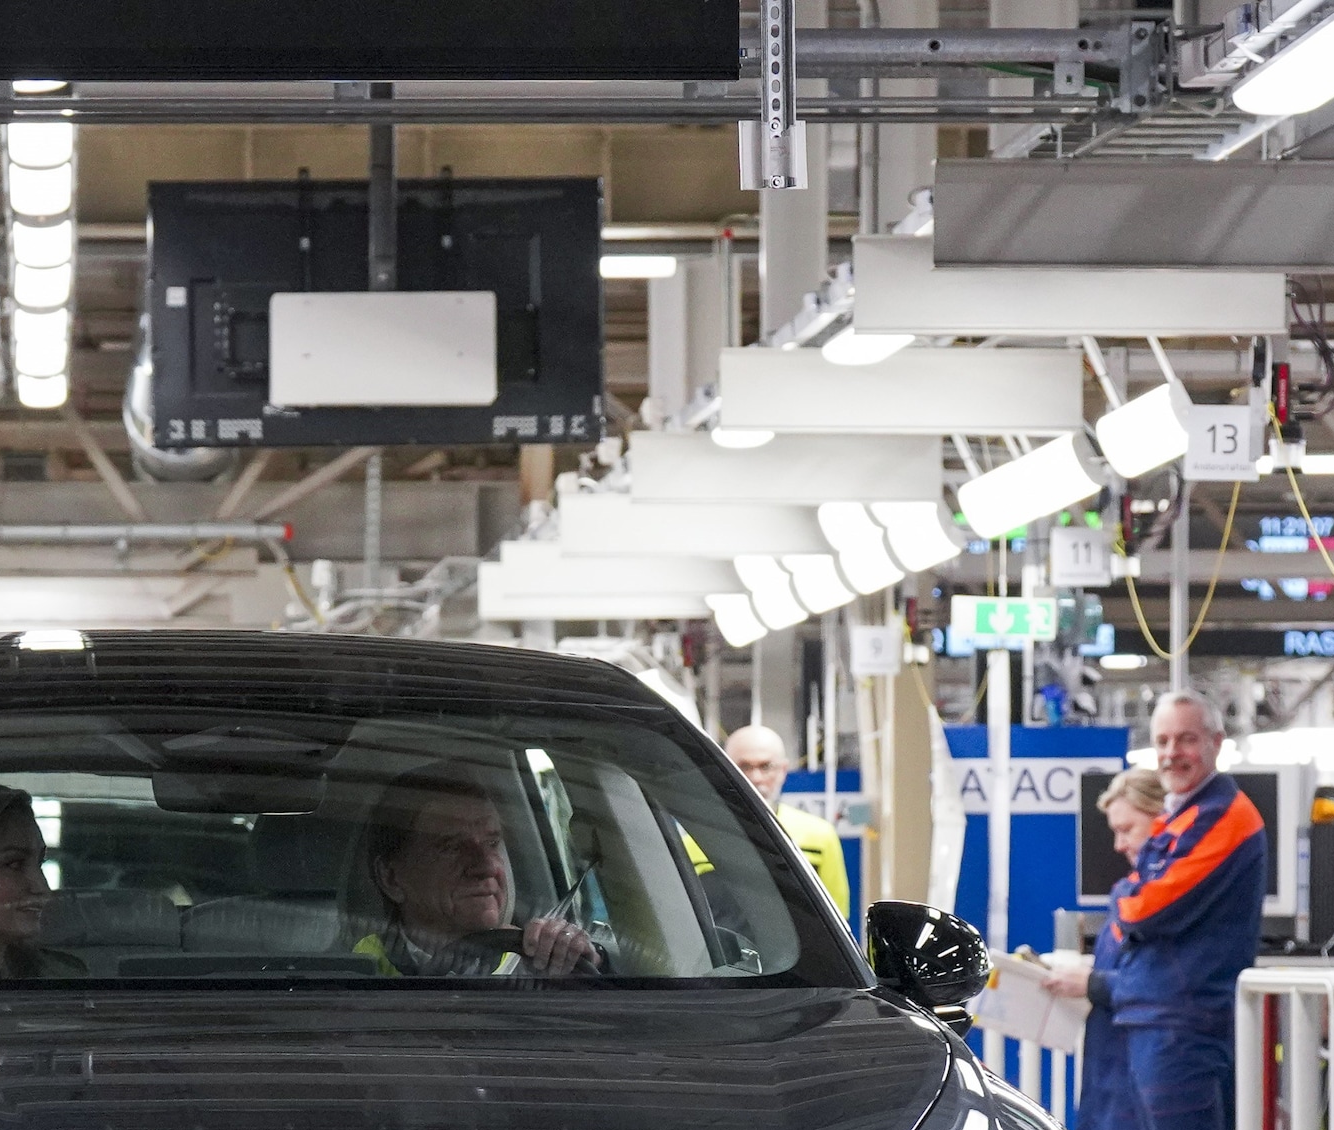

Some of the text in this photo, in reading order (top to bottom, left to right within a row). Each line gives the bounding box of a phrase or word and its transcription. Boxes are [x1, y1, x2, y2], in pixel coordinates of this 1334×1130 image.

[1206, 423, 1239, 454] 13
[1071, 540, 1093, 565] 11
[960, 766, 1107, 803] AAC
